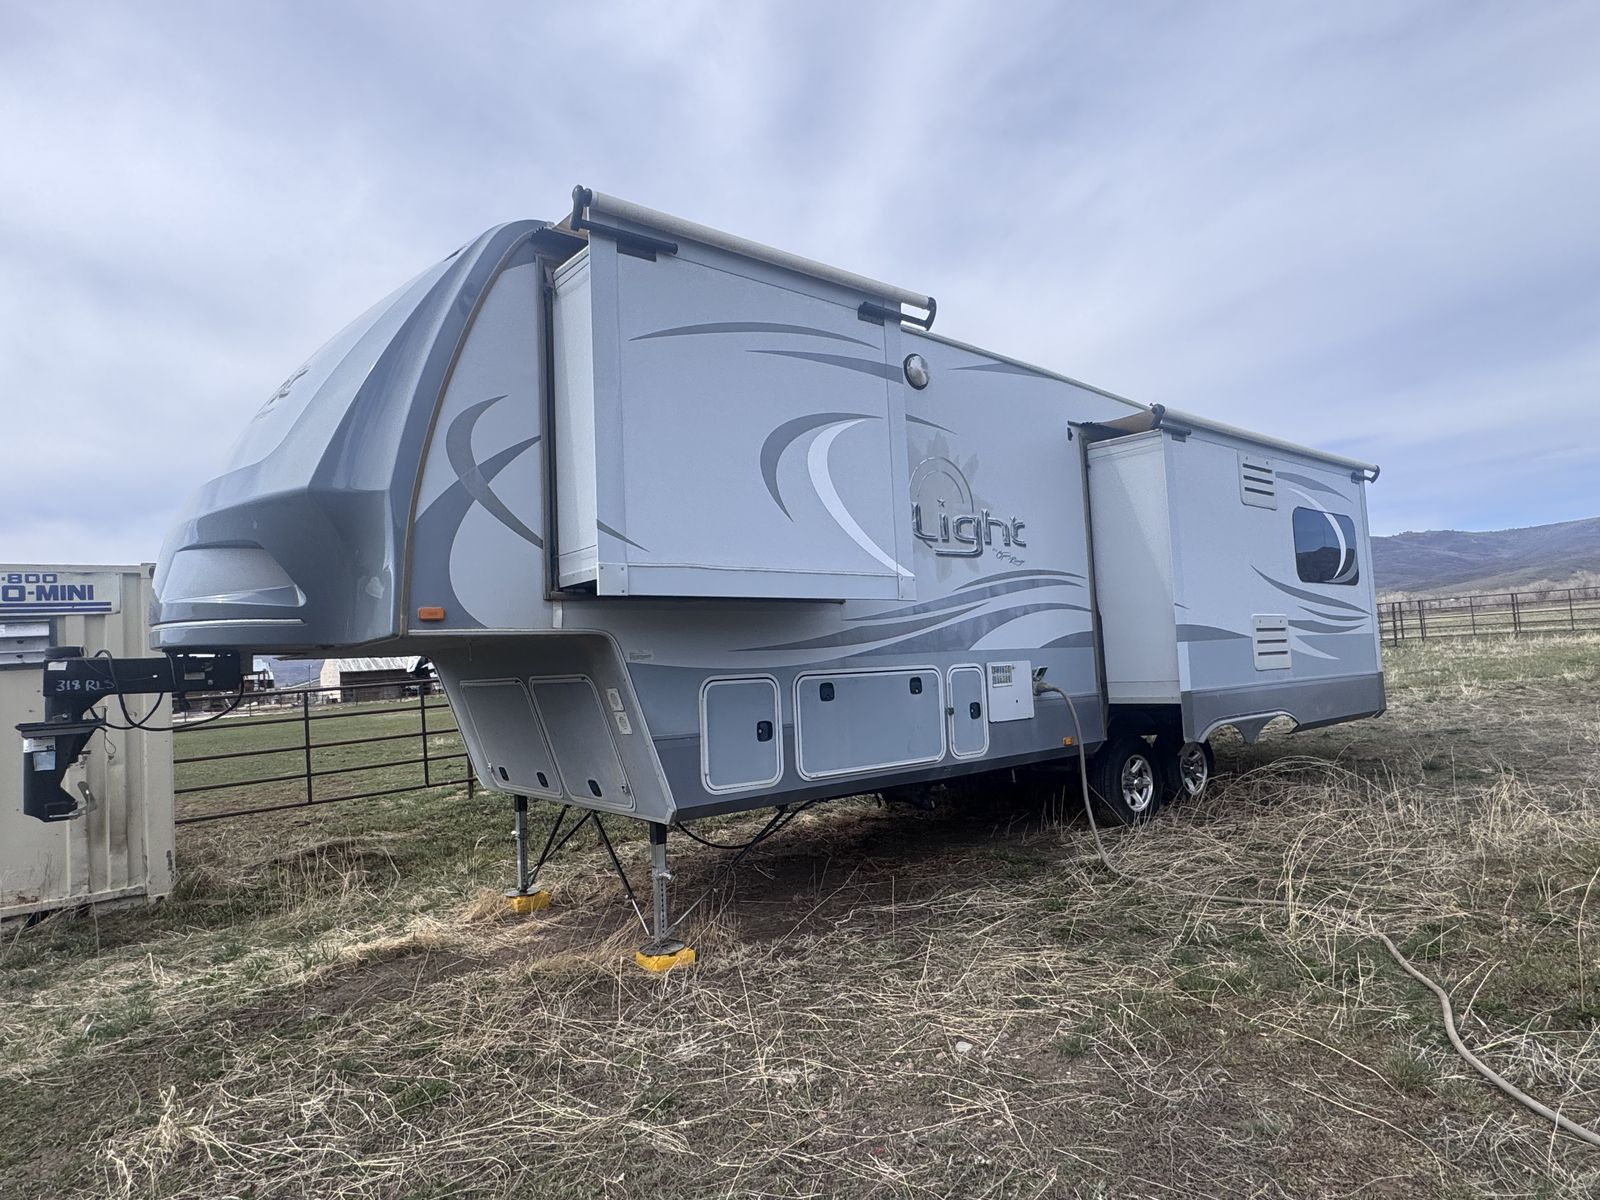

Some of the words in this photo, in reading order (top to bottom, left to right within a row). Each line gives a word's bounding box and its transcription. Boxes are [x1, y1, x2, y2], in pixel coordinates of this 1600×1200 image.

[911, 498, 1027, 558] Light
[1, 585, 94, 601] O-MINI
[56, 680, 80, 691] 318
